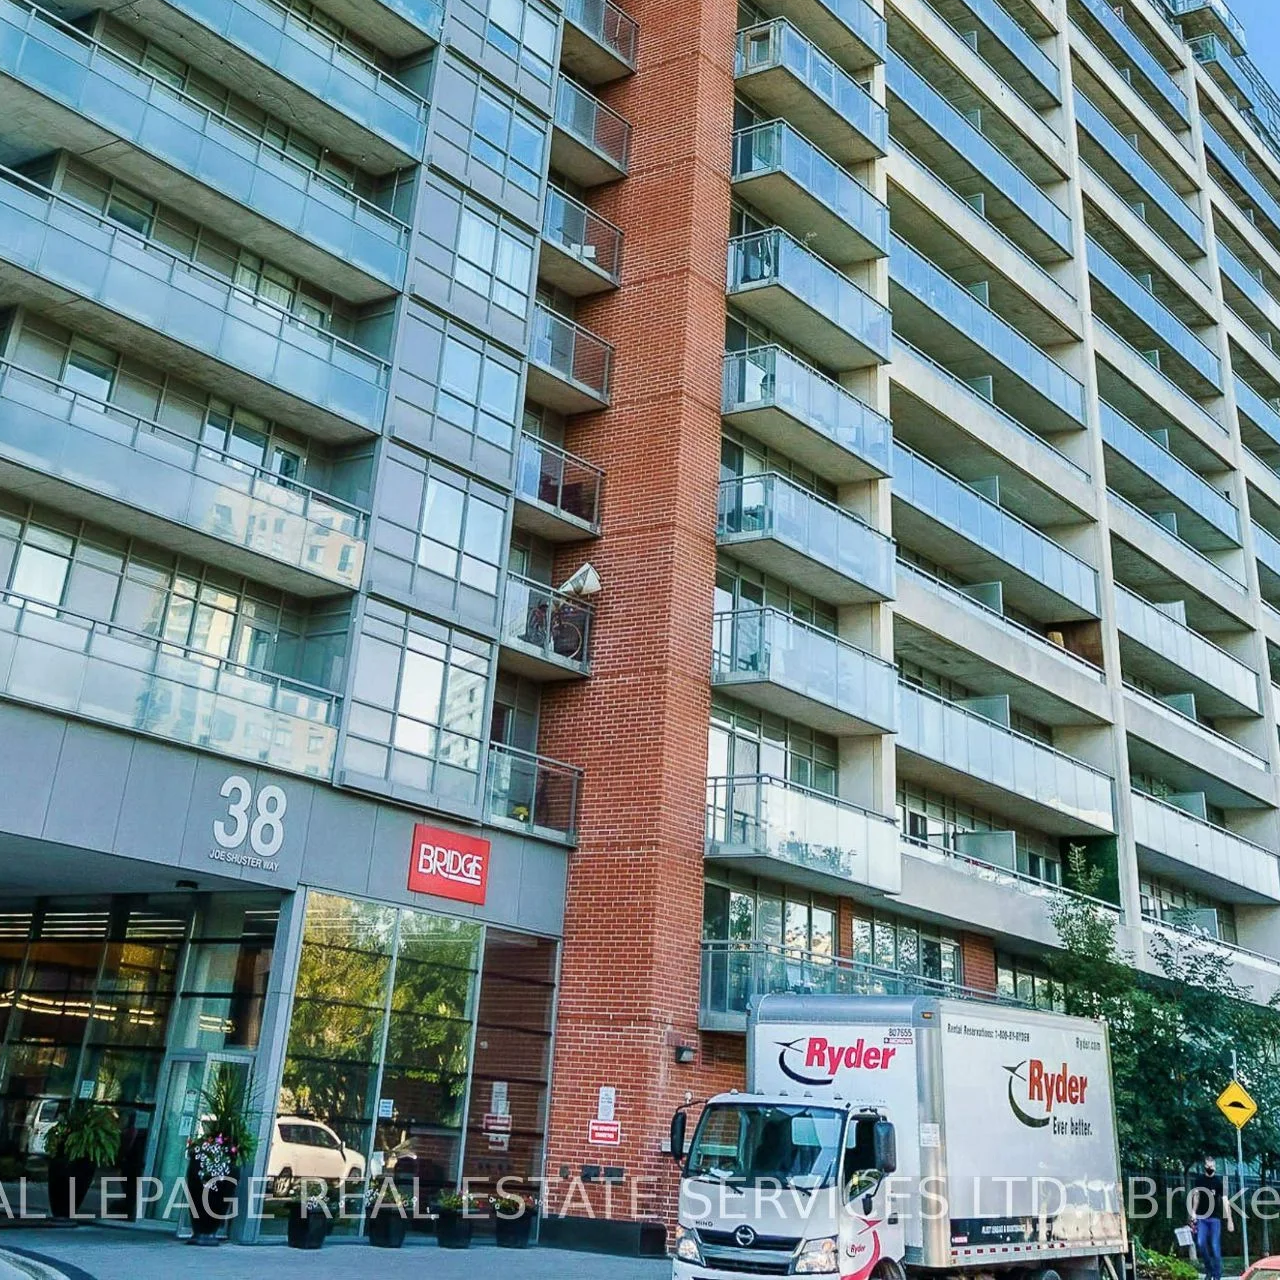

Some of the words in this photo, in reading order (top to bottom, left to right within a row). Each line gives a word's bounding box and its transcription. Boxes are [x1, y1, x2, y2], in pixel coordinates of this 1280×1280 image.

[213, 775, 287, 857] 38
[209, 848, 226, 861] JOE
[226, 852, 261, 868] SHUSTER
[262, 860, 279, 872] WAY
[418, 843, 483, 885] BRIDGE
[805, 1037, 896, 1075] Ryder
[1029, 1059, 1088, 1112] Ryder
[1053, 1117, 1067, 1135] Ever
[695, 1220, 713, 1228] HINO
[851, 1243, 866, 1254] Ryder
